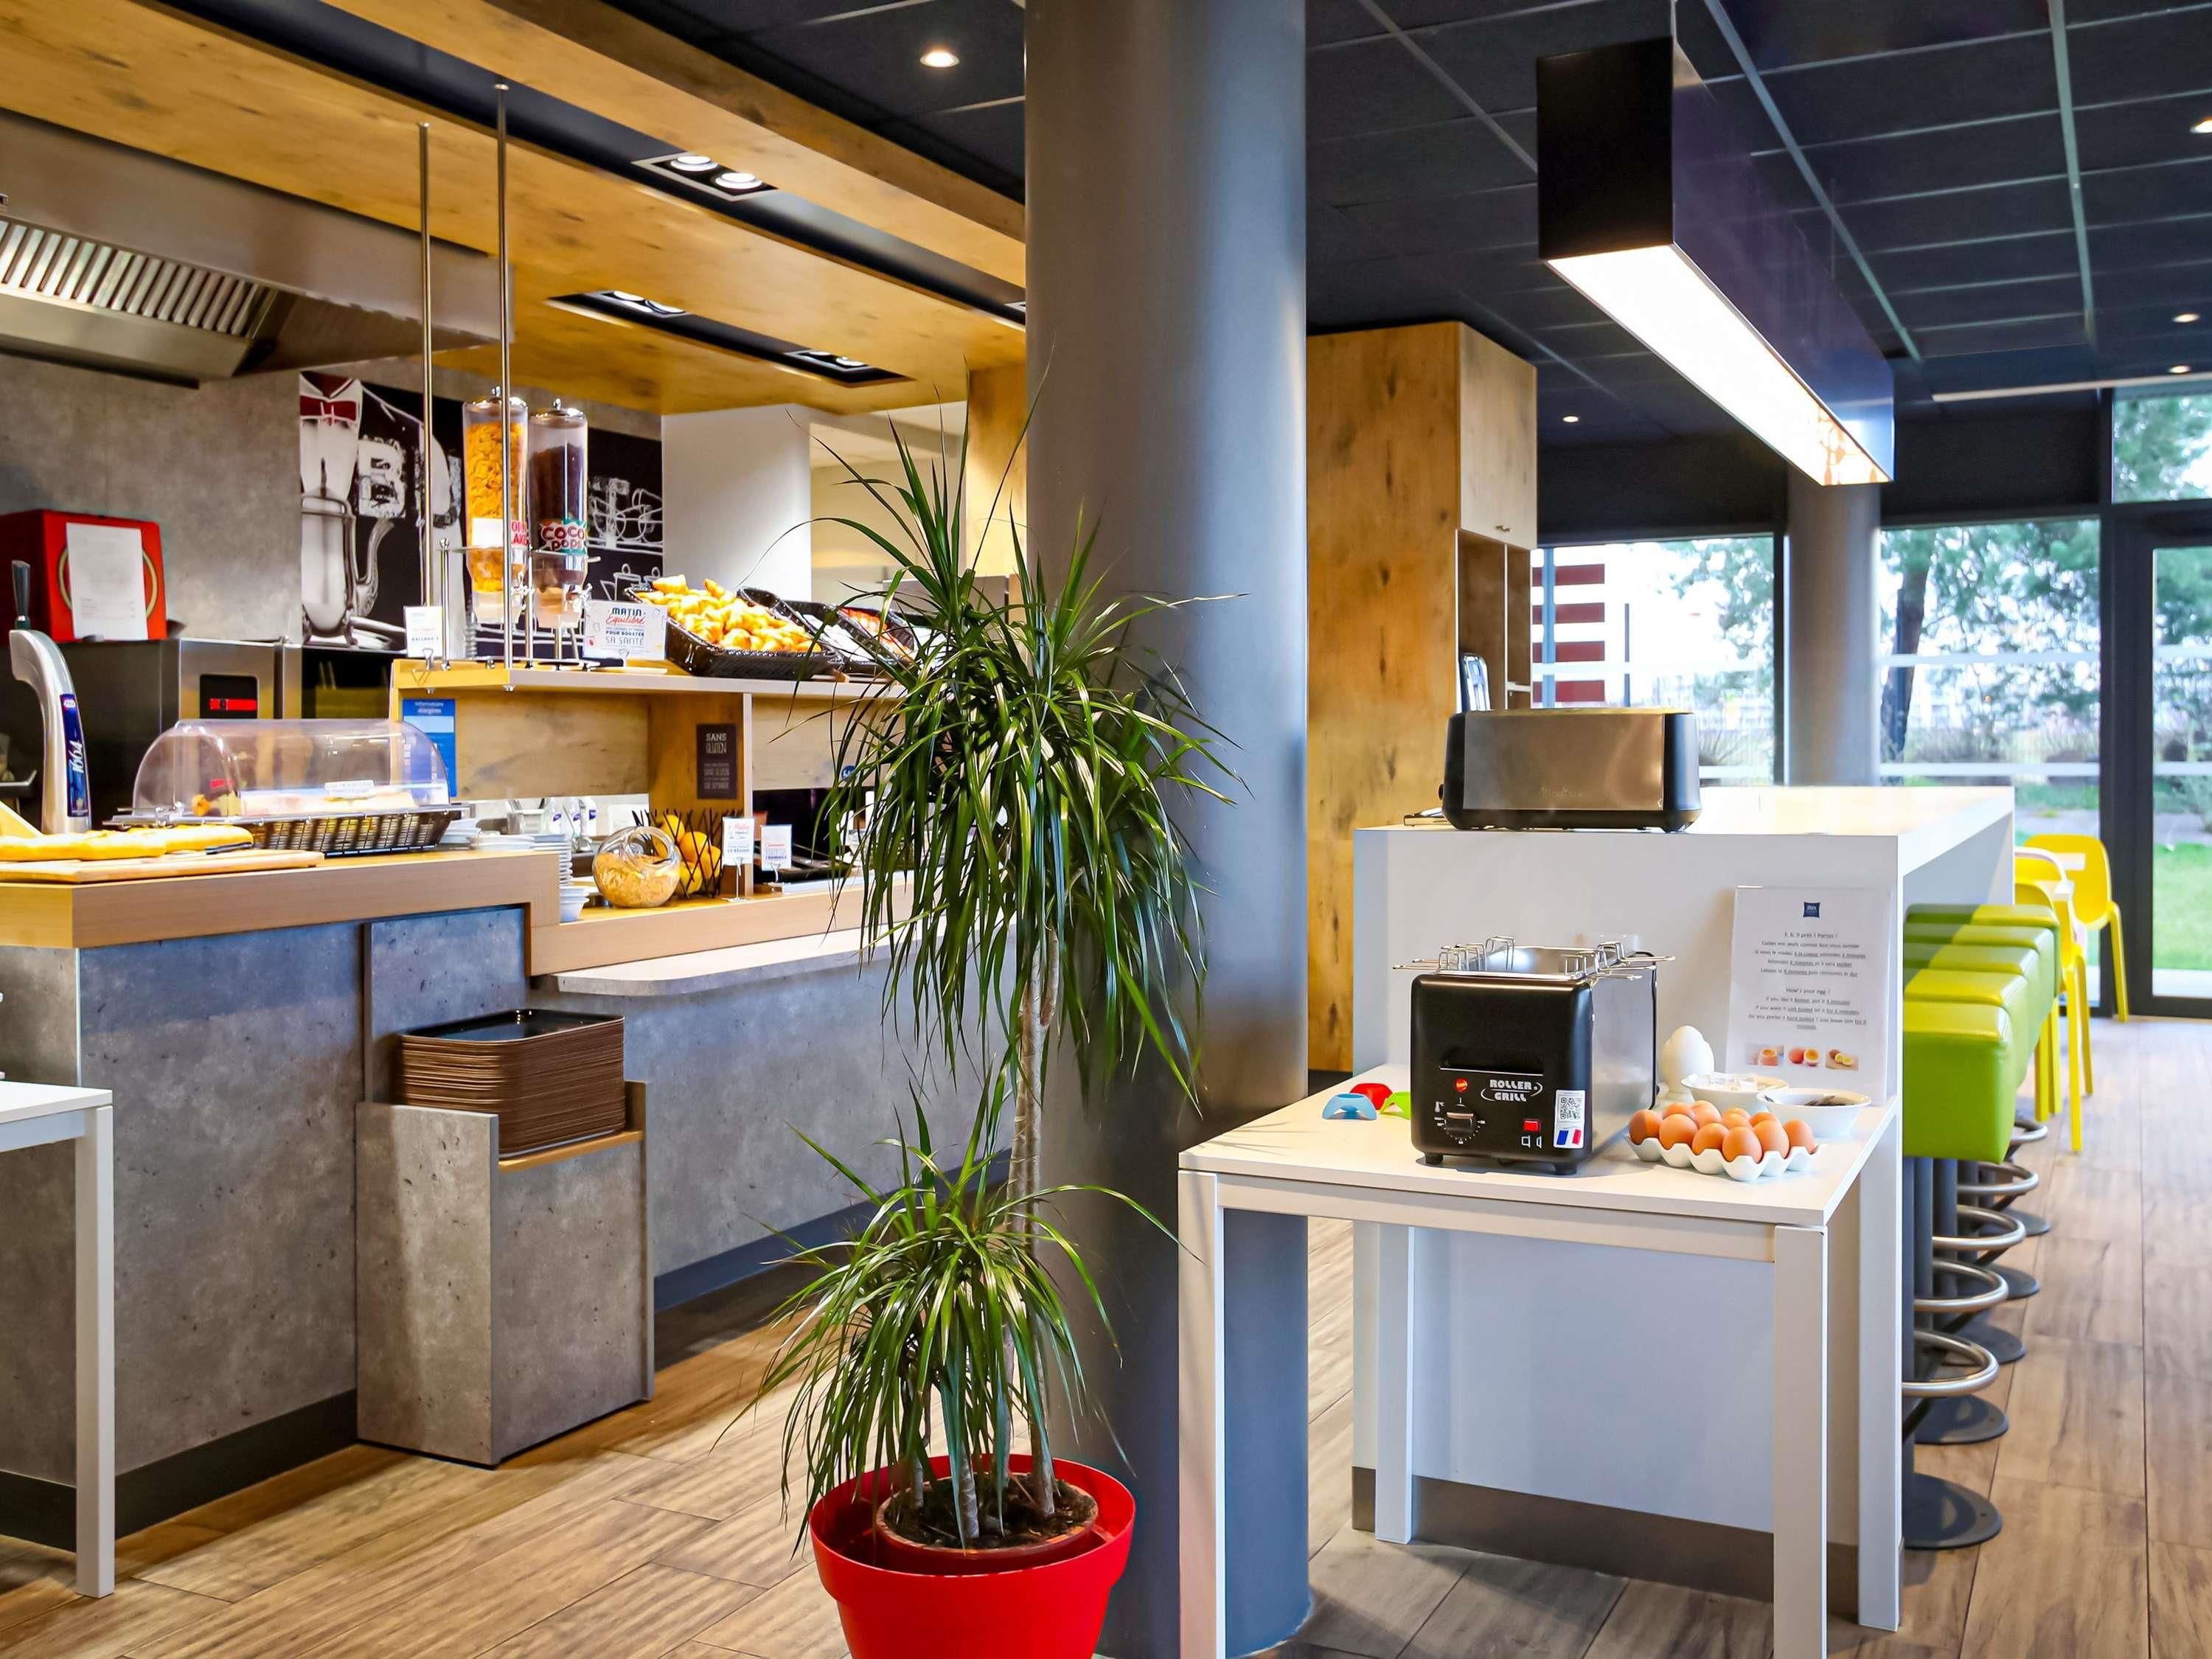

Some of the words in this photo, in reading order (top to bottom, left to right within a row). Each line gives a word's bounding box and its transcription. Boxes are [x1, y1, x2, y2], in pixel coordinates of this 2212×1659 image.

[612, 608, 641, 616] MATIN
[706, 733, 727, 742] SANS
[69, 740, 84, 773] 1664
[1489, 1079, 1532, 1091] ROLLER
[1494, 1092, 1527, 1102] GRILL
